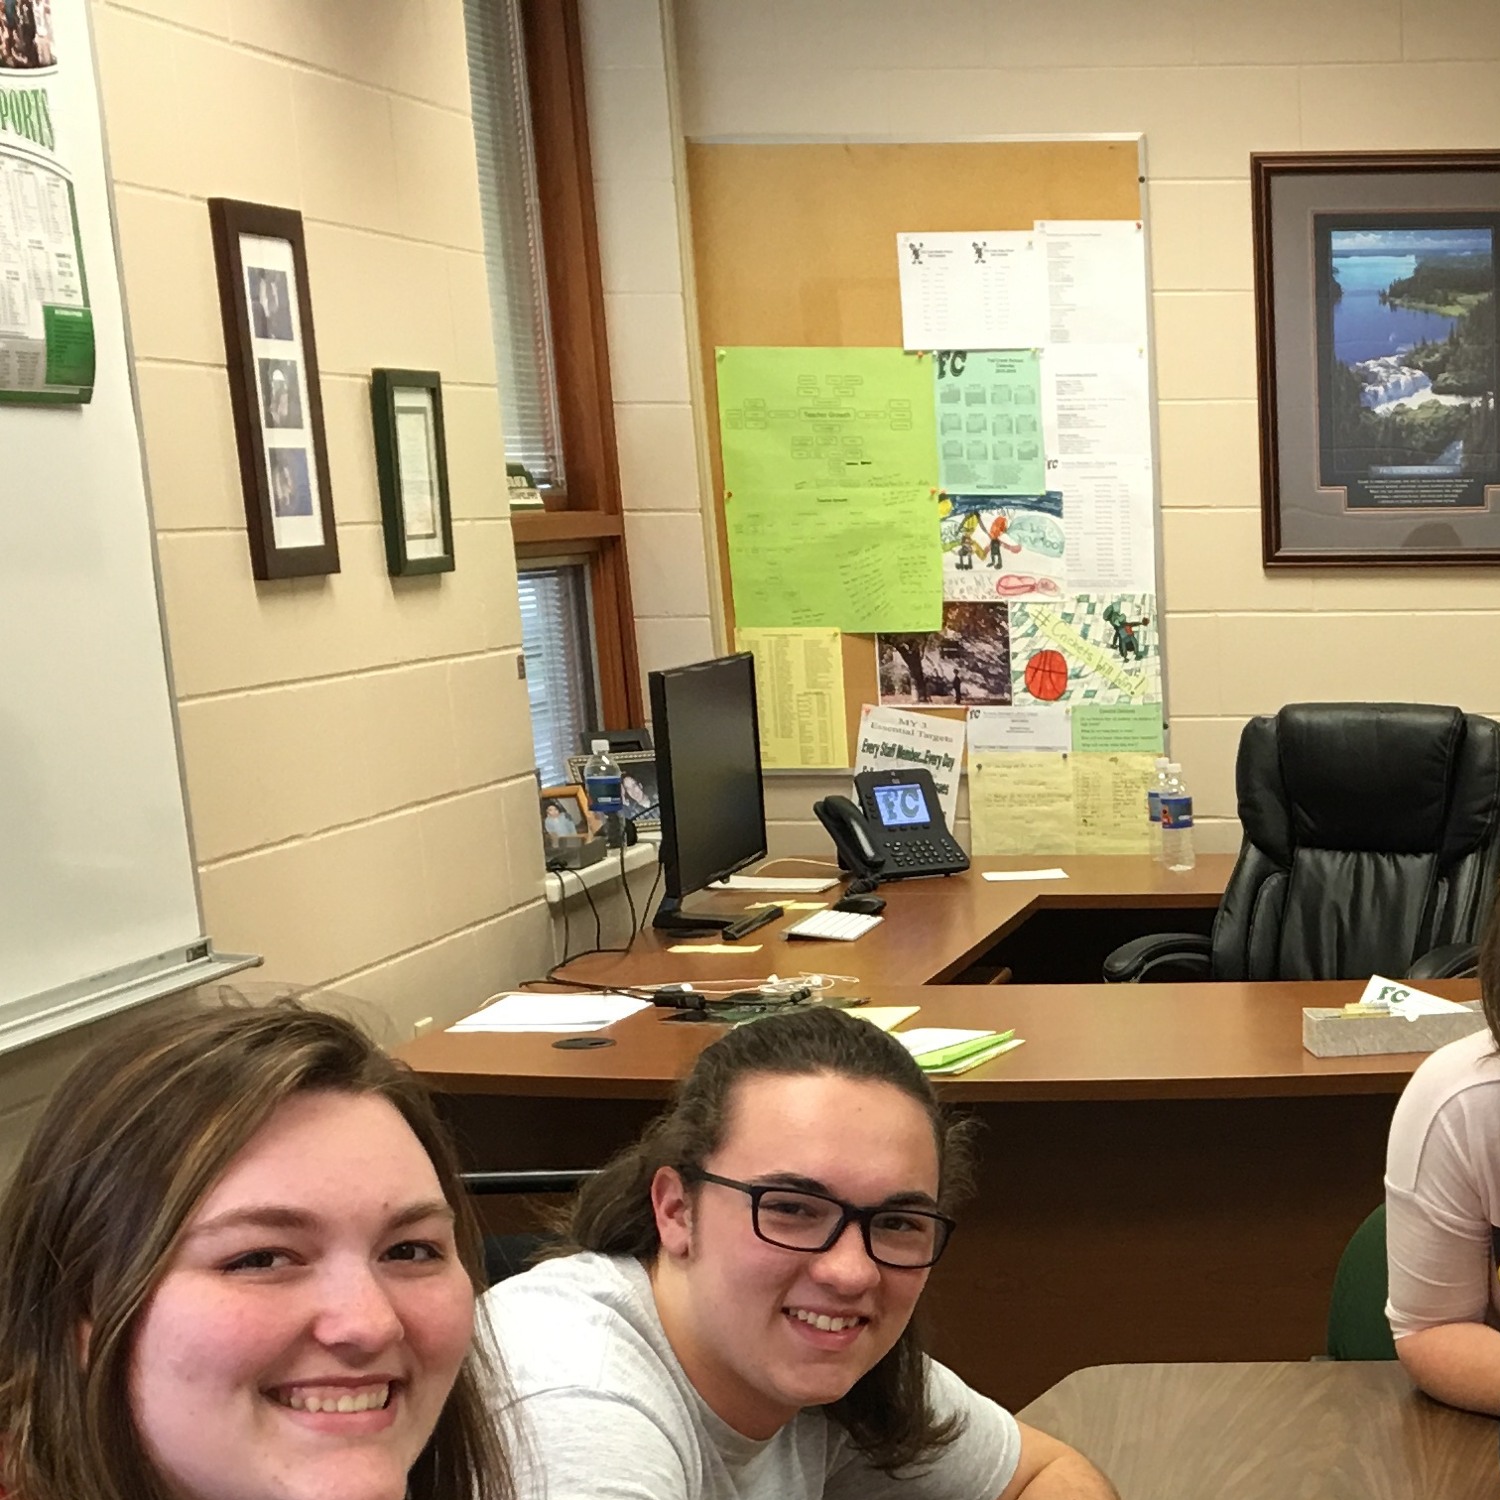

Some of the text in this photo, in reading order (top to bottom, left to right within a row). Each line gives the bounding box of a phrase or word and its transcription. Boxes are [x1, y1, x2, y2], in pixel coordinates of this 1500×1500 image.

[870, 721, 953, 744] Essential Targets
[898, 718, 917, 728] MY
[882, 788, 921, 820] FC
[1376, 986, 1410, 1004] FC
